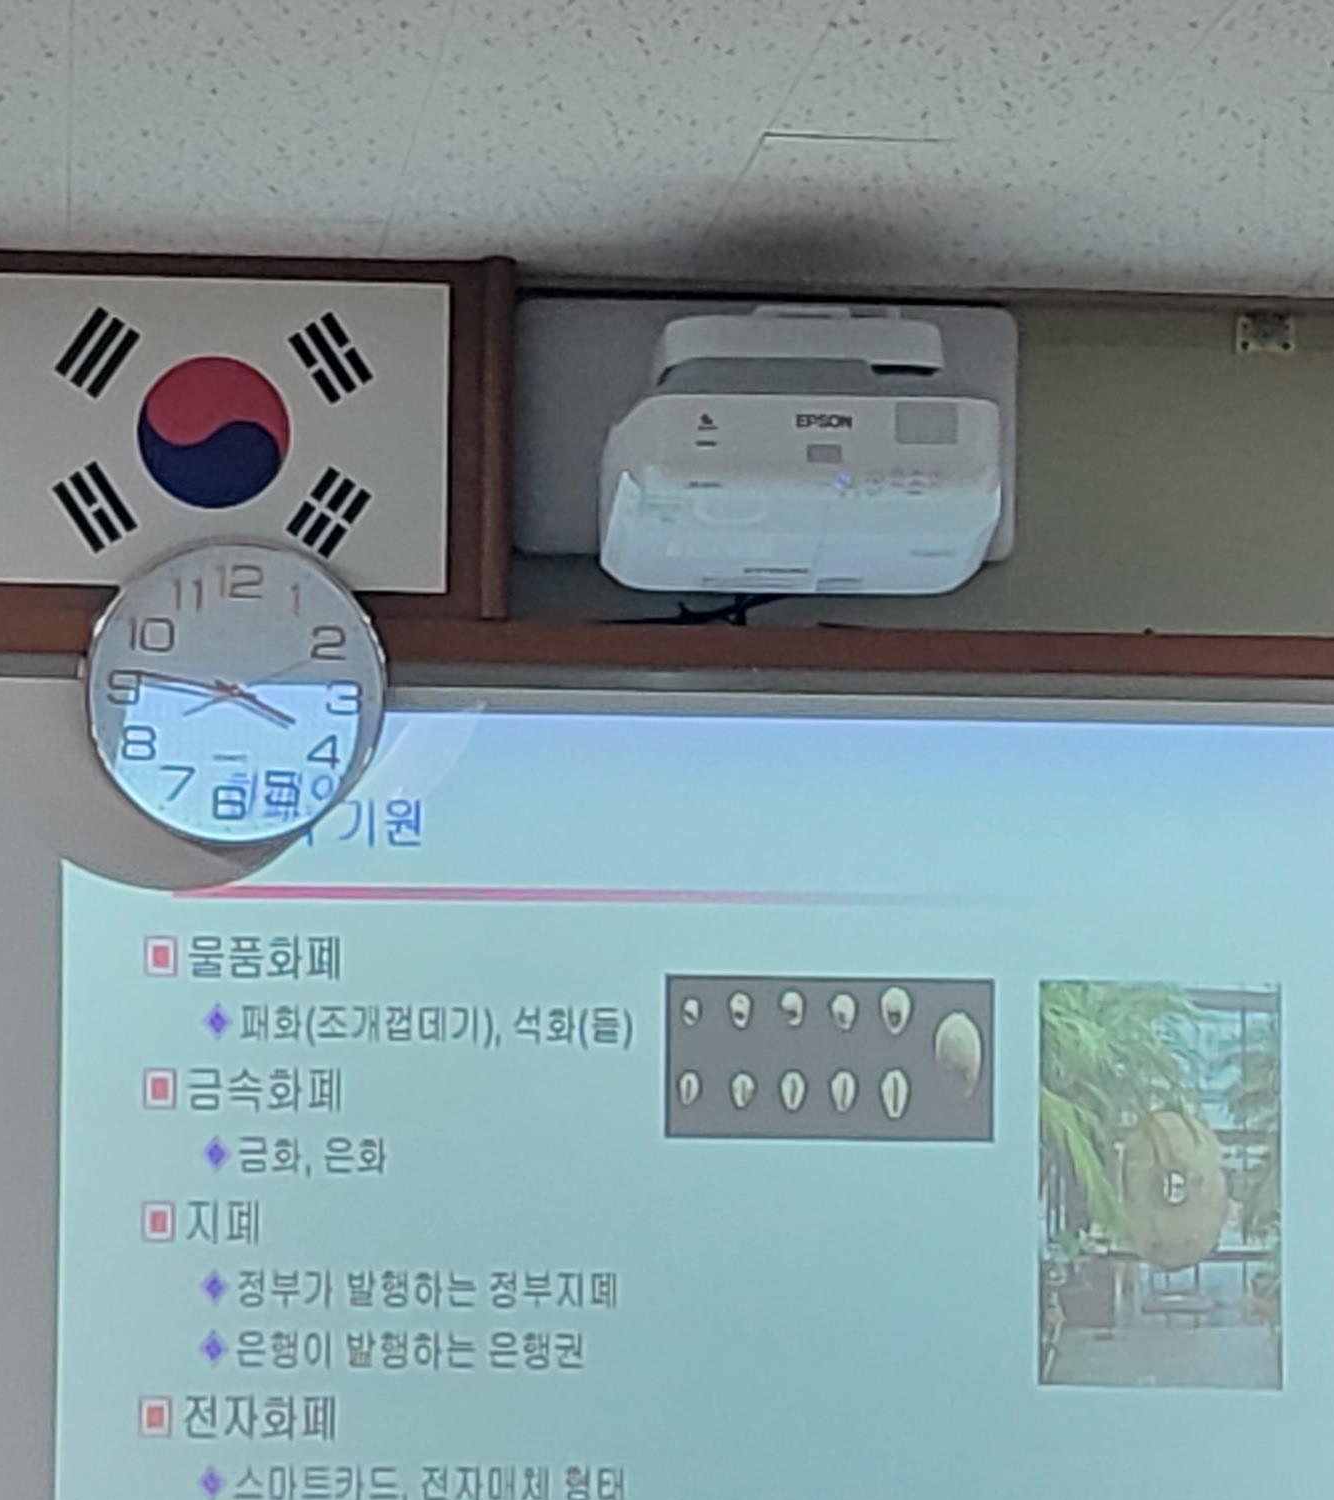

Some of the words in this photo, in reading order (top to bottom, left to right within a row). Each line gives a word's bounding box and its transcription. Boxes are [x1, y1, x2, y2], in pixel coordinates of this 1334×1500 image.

[796, 414, 853, 429] EPSON
[174, 578, 203, 612] 11
[216, 565, 264, 598] 12
[290, 583, 301, 616] 1
[129, 617, 176, 652] 10
[310, 625, 347, 660] 2
[108, 670, 143, 705] 9
[326, 681, 363, 716] 3
[122, 725, 157, 761] 8
[307, 735, 340, 770] 4
[160, 766, 196, 801] 7
[213, 786, 247, 820] 6
[339, 800, 421, 847] 기원
[188, 935, 342, 981] 물품화폐
[187, 1067, 342, 1112] 금속화폐
[238, 1136, 312, 1177] 금화,
[323, 1136, 387, 1174] 은화
[185, 1200, 262, 1245] 지폐
[237, 1270, 334, 1309] 정부가
[347, 1270, 477, 1310] 발행하는
[489, 1270, 619, 1309] 정부지폐
[236, 1331, 333, 1370] 은행이
[347, 1331, 476, 1370] 발행하는
[489, 1331, 585, 1371] 은행권
[183, 1395, 338, 1442] 전자화폐
